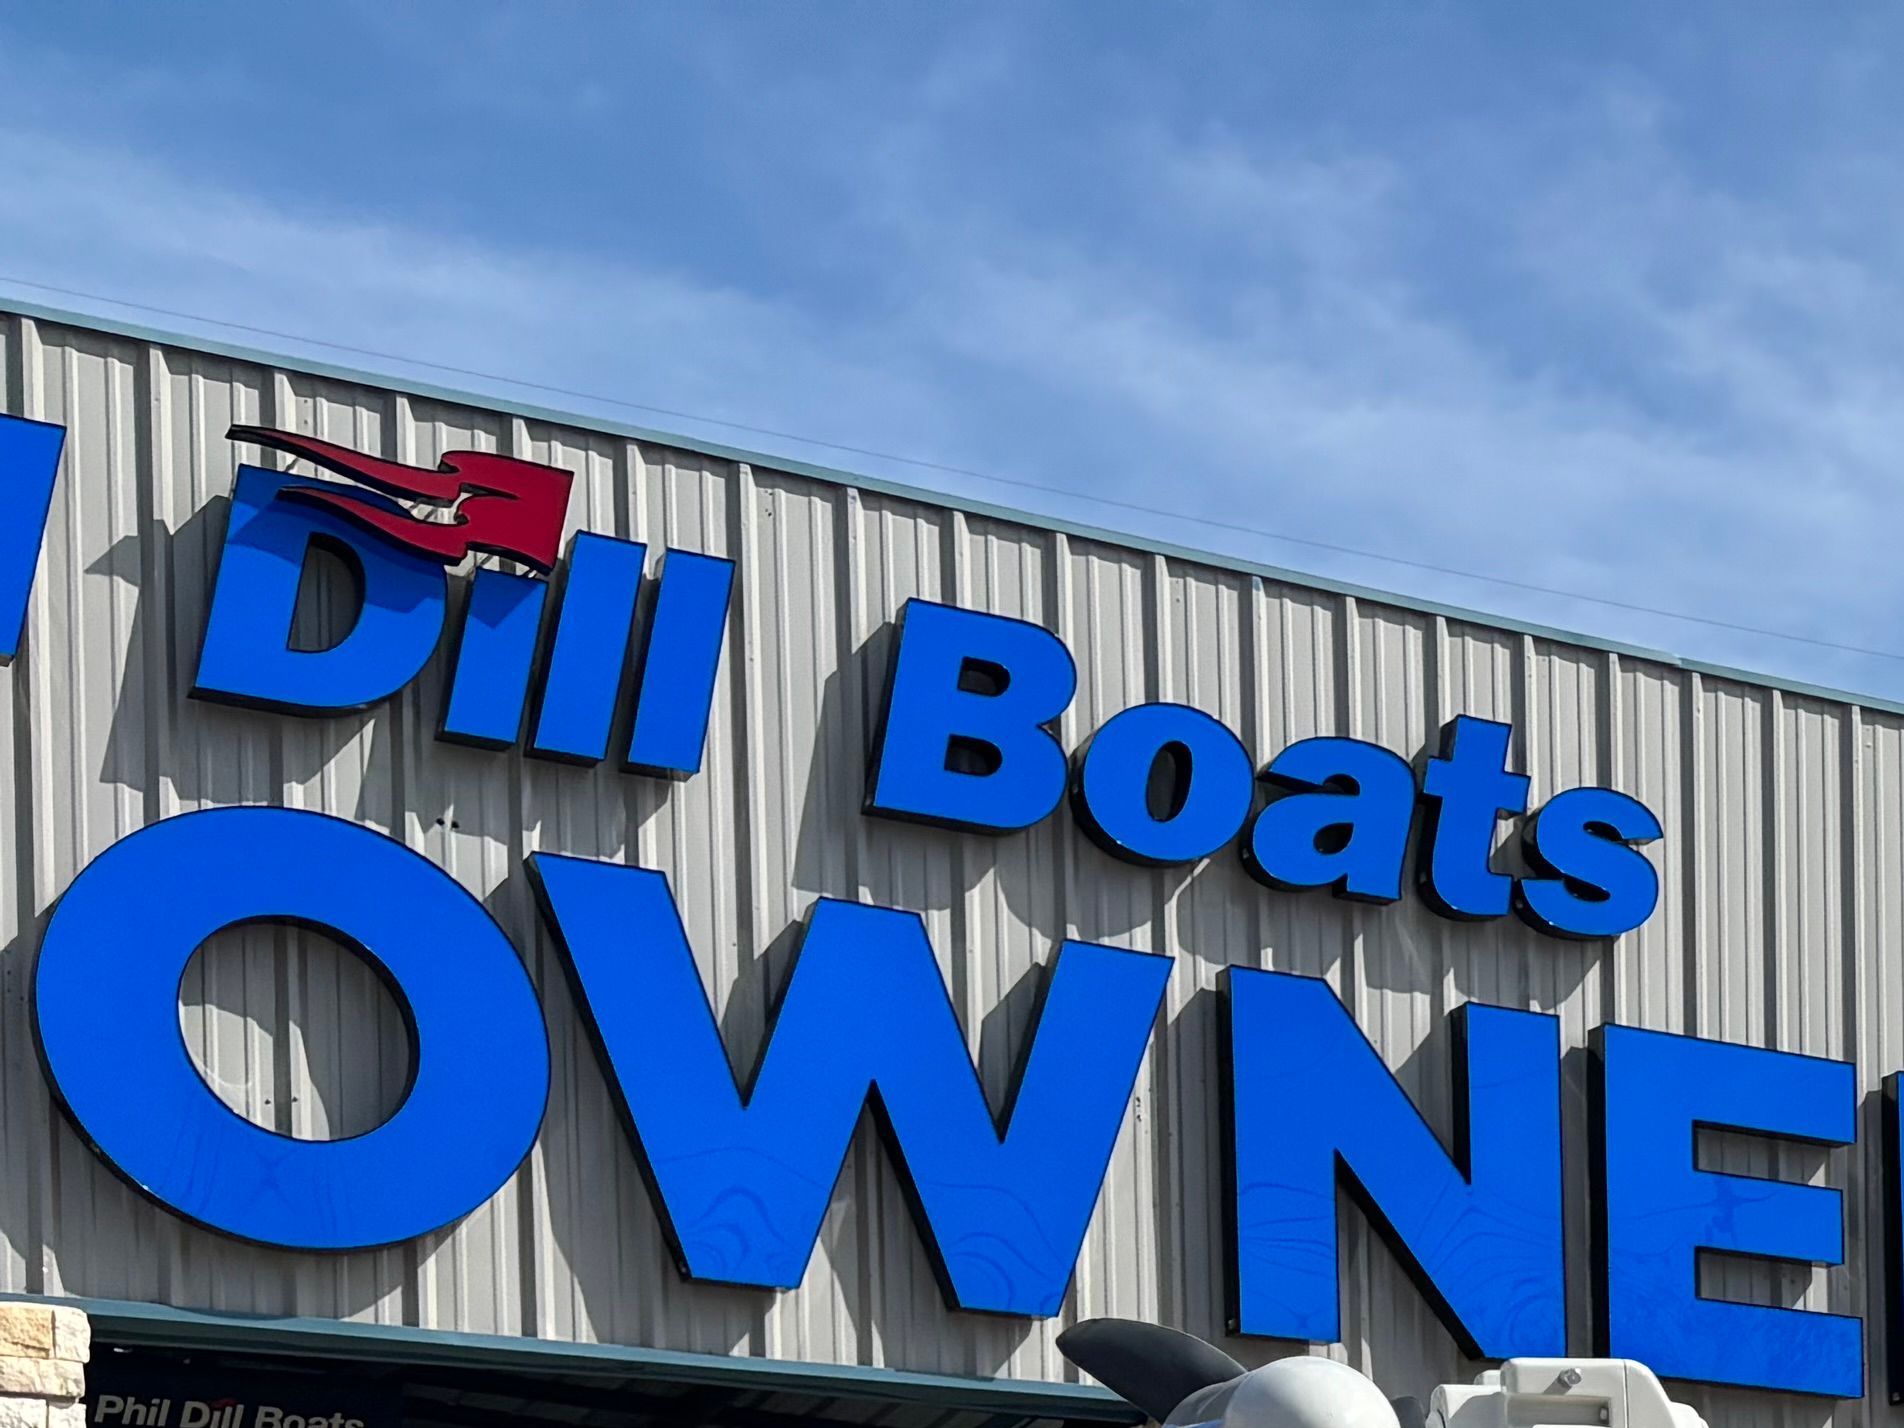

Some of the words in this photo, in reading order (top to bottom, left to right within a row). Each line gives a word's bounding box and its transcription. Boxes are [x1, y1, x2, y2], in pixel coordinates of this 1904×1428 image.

[192, 455, 734, 778] Dill
[864, 596, 1667, 942] Boats
[94, 1394, 171, 1428] Phil
